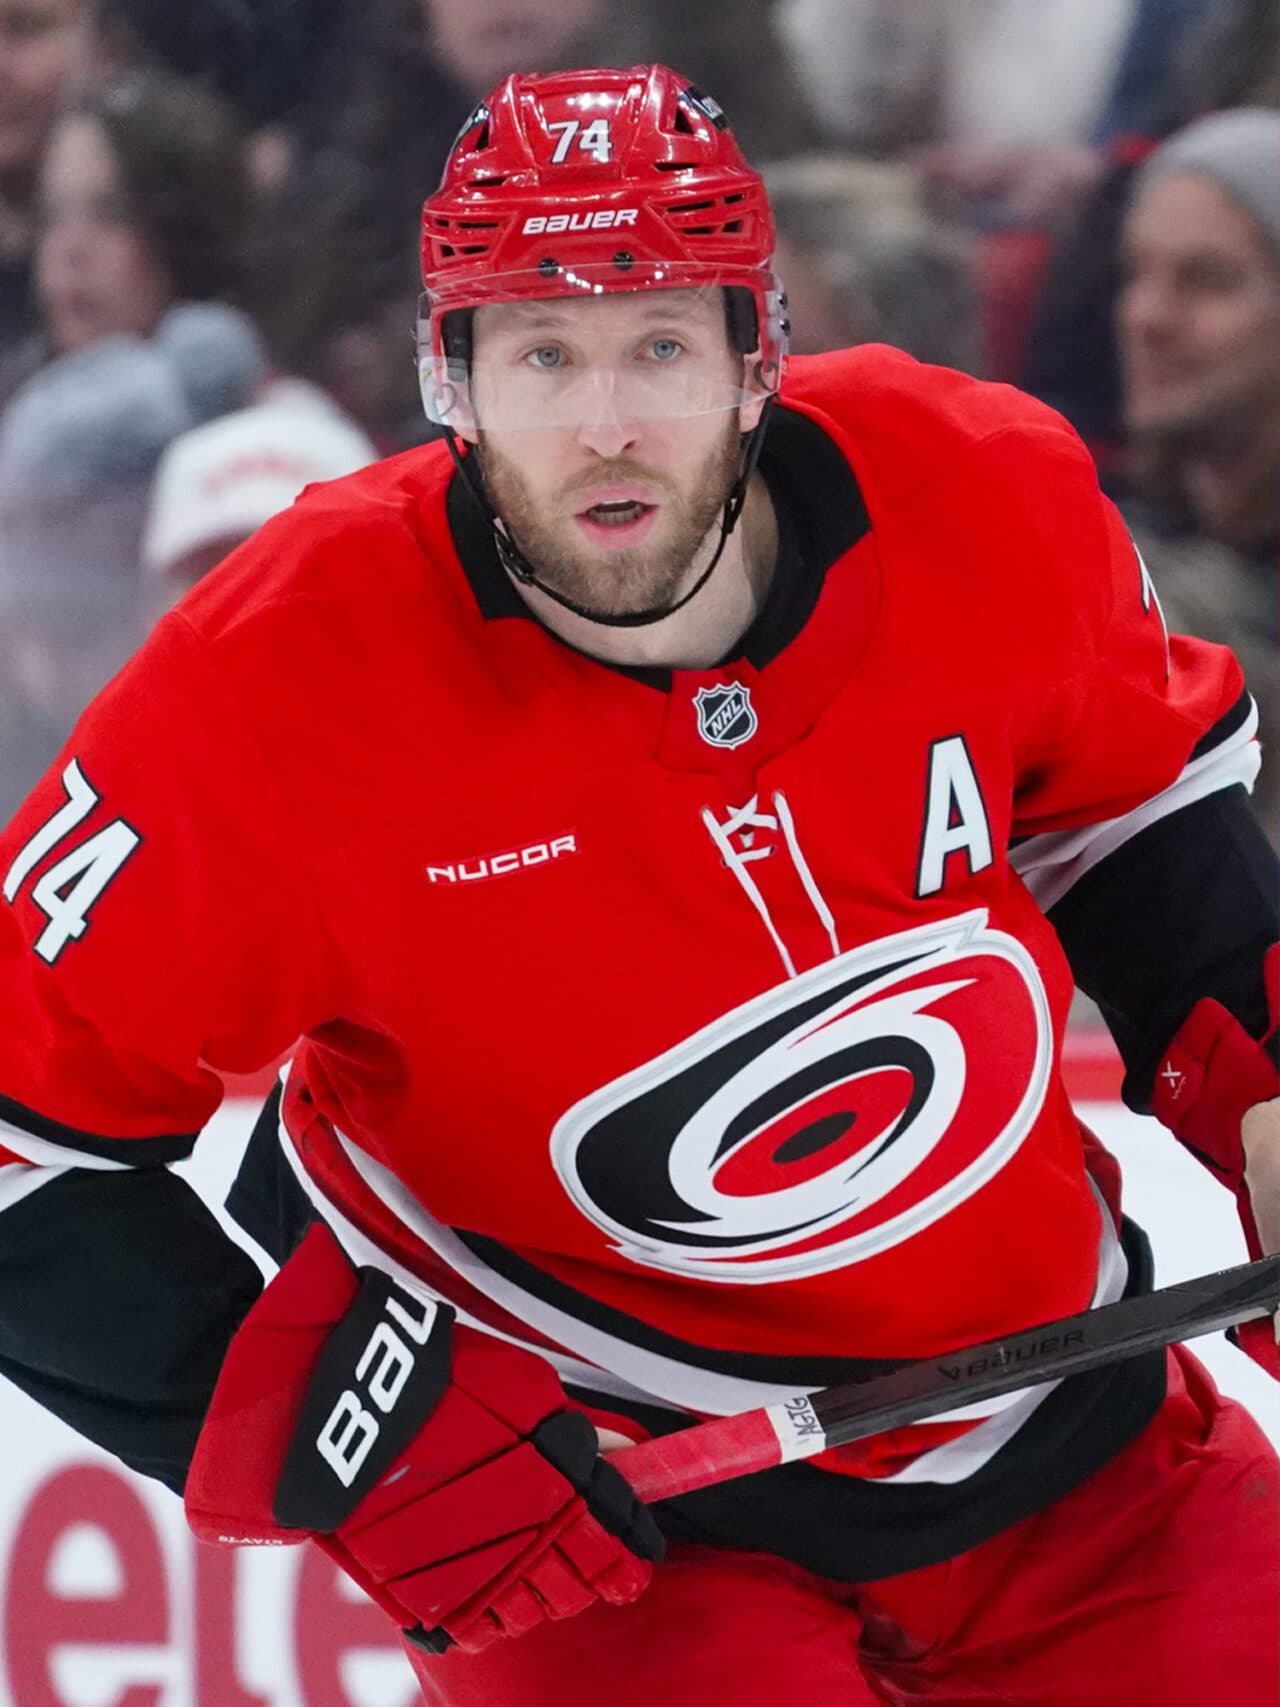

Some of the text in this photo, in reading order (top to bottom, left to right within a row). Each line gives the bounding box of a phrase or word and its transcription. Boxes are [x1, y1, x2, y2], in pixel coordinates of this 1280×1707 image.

[549, 119, 612, 164] 74
[522, 208, 638, 235] BAUER
[914, 732, 993, 898] A
[2, 756, 143, 965] 74
[426, 834, 576, 883] NUCOR
